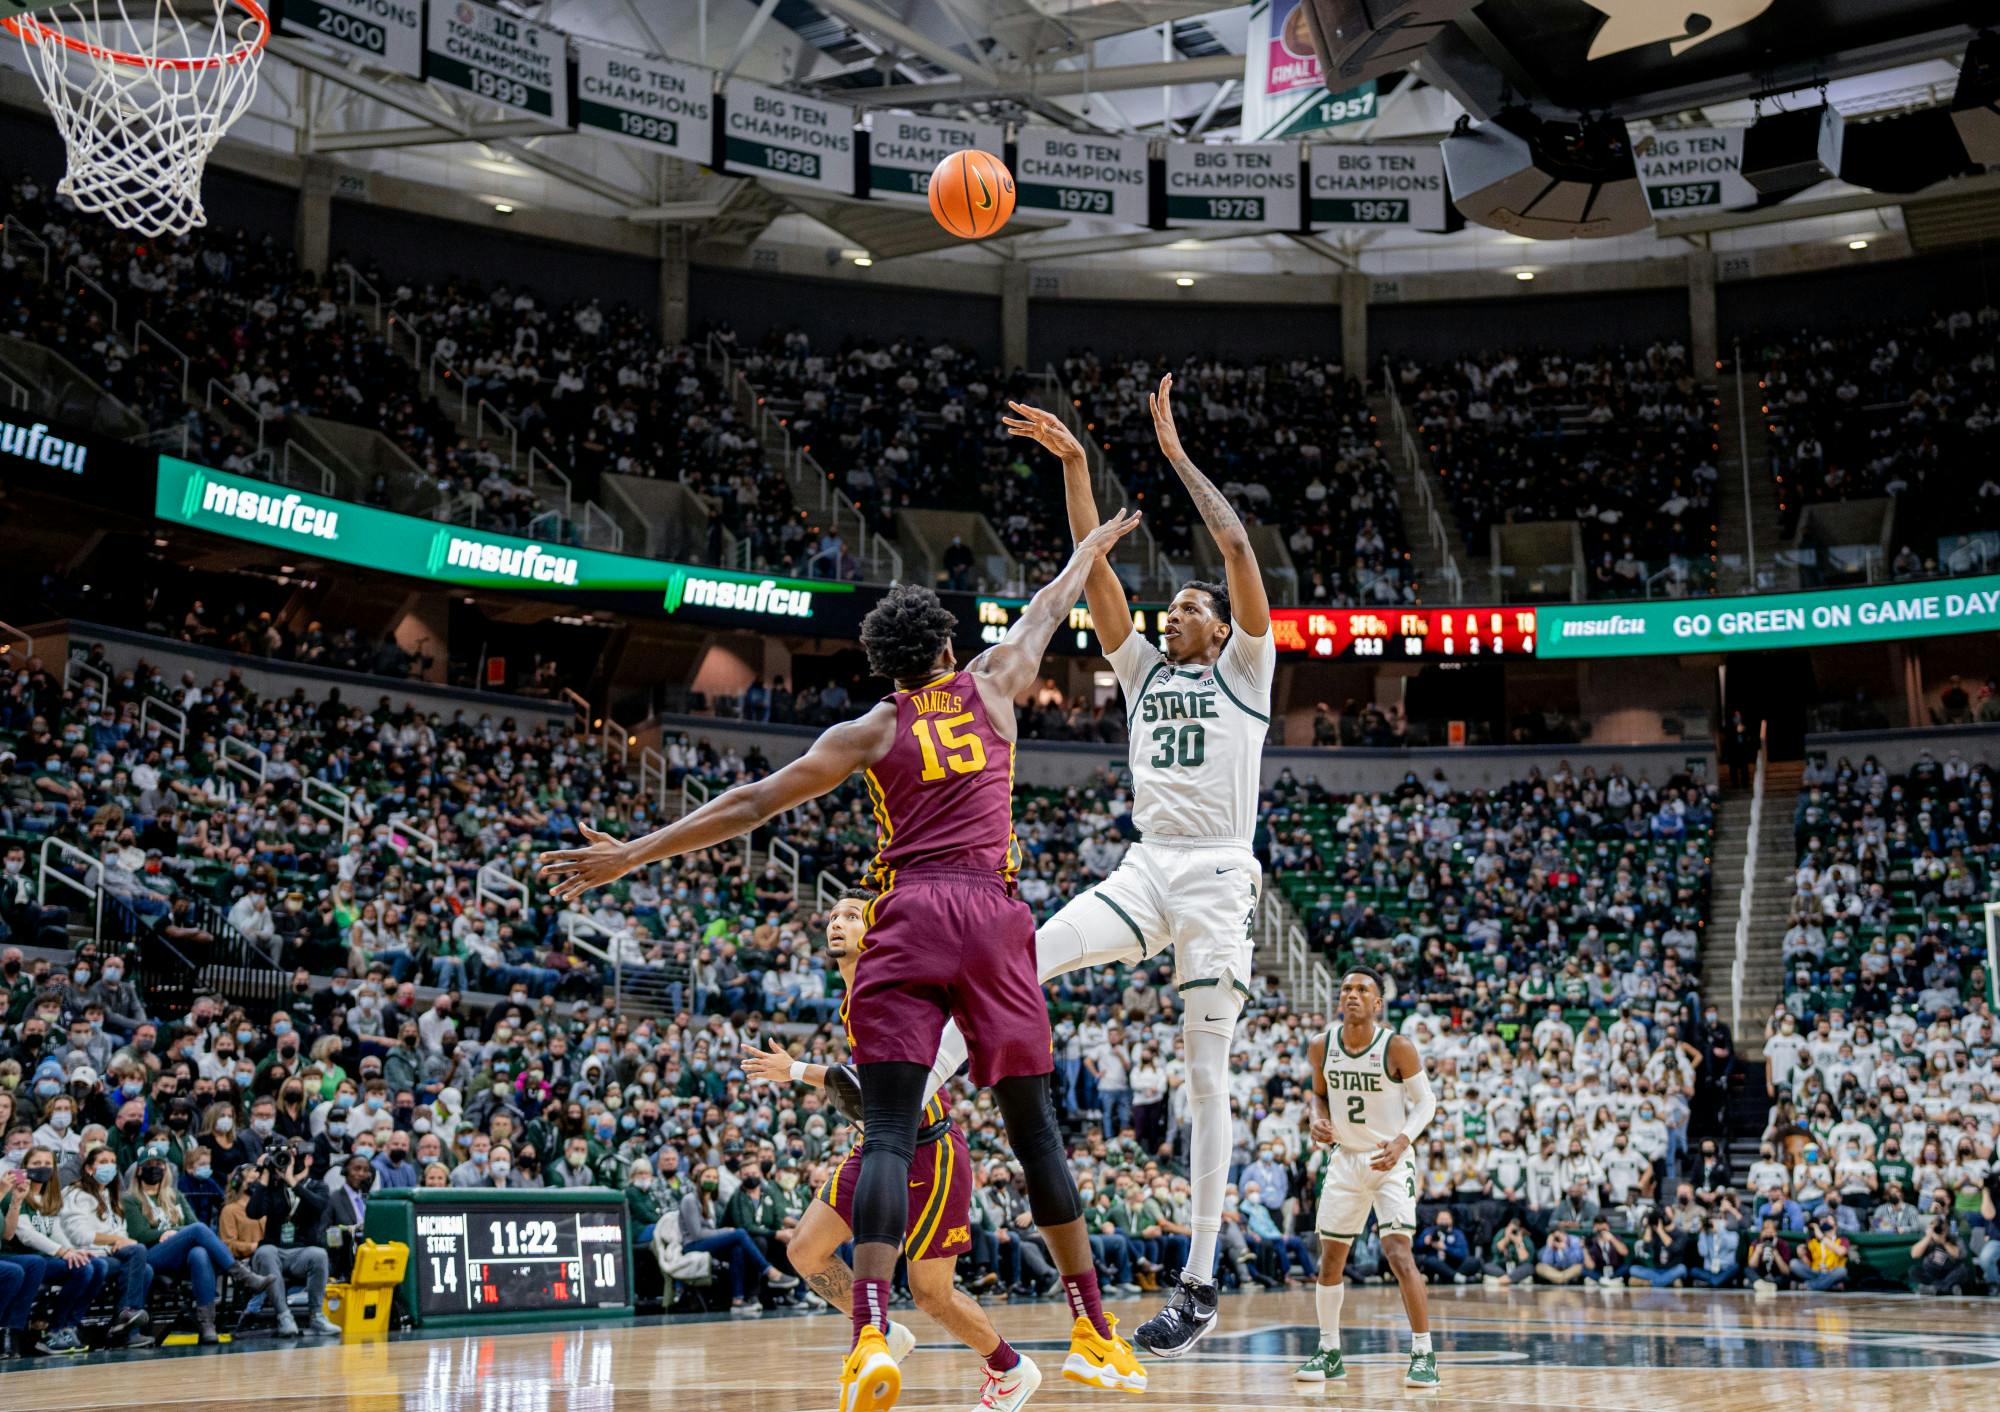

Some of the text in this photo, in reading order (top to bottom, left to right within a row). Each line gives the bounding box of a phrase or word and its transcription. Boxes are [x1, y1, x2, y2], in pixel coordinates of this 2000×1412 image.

[317, 8, 383, 50] 2000
[447, 20, 550, 68] TOURNAMENT
[446, 37, 553, 87] CHAMPIONS
[608, 61, 685, 93] BIG TEN
[468, 67, 529, 107] 1999
[584, 76, 708, 119] CHAMPIONS
[754, 96, 827, 126] BIG TEN
[1320, 92, 1375, 122] 1957
[619, 112, 674, 142] 1999
[731, 113, 849, 152] CHAMPIONS
[898, 124, 975, 146] BIG TEN
[1045, 141, 1120, 162] BIG TEN
[1686, 136, 1726, 153] TEN
[765, 148, 816, 176] 1998
[1022, 158, 1143, 185] CHAMPIONS
[1194, 152, 1271, 168] BIG TEN
[1338, 155, 1416, 171] BIG TEN
[1171, 171, 1295, 189] CHAMPIONS
[1315, 174, 1440, 191] CHAMPIONS
[1057, 189, 1108, 212] 1979
[1208, 199, 1260, 219] 1978
[1351, 201, 1404, 220] 1967
[1660, 184, 1715, 207] 1957
[0, 421, 88, 475] ufcu
[203, 481, 338, 539] msufcu
[447, 537, 578, 586] msufcu
[683, 577, 812, 617] msufcu
[1440, 613, 1453, 635] R
[1465, 613, 1479, 635] A
[1563, 590, 2000, 637] msufcu GO GREEN ON GAME DAY
[1521, 635, 1533, 653] 4
[911, 690, 962, 715] DANIELS
[1143, 691, 1219, 722] STATE
[911, 711, 987, 781] 15
[1151, 724, 1205, 768] 30
[1328, 1070, 1383, 1092] STATE
[1347, 1095, 1366, 1124] 2
[426, 1236, 457, 1253] STATE
[489, 1221, 558, 1255] 11:22
[430, 1256, 458, 1293] 14
[593, 1252, 616, 1288] 10
[473, 1284, 482, 1303] 4
